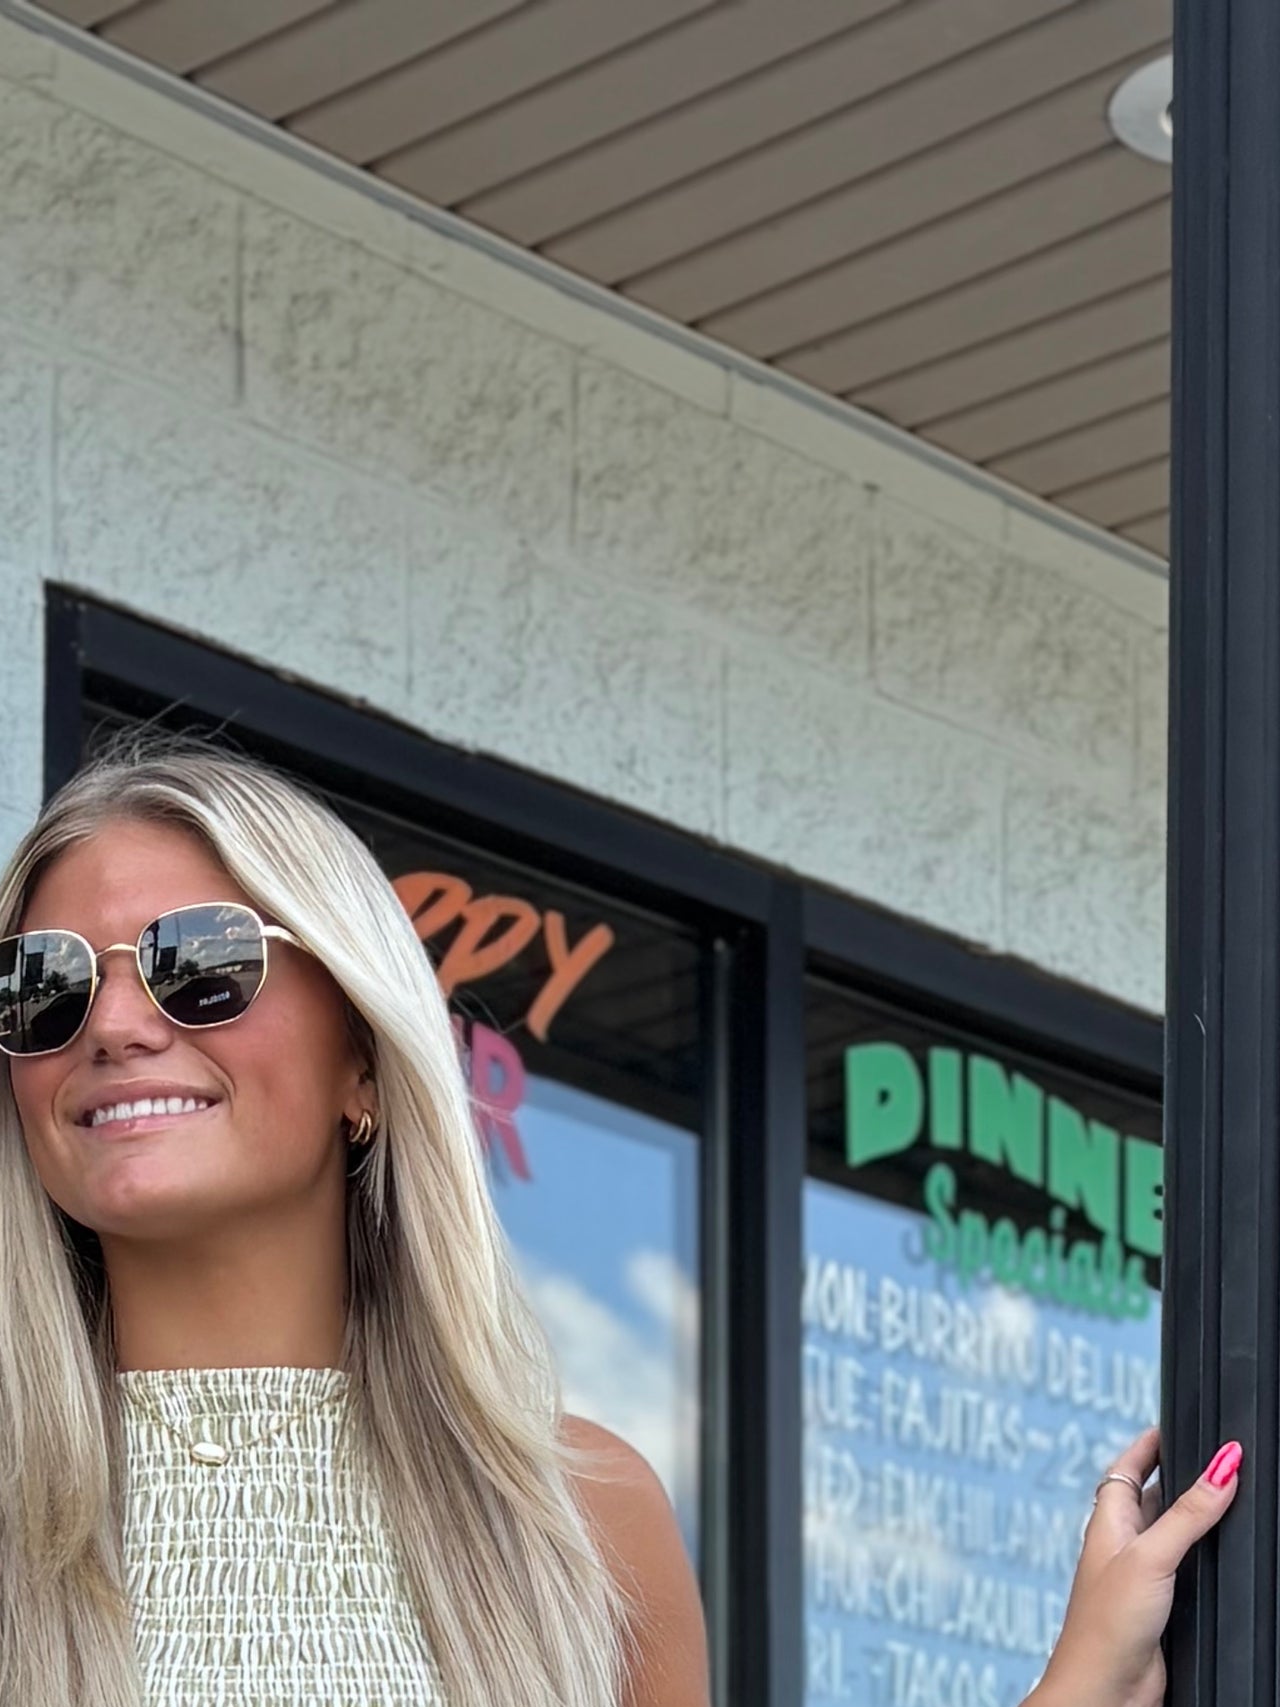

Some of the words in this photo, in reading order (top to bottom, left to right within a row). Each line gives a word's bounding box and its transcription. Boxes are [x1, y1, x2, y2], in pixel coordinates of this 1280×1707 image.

[389, 871, 615, 1043] PPY
[845, 1041, 1164, 1259] DINNE
[924, 1163, 1150, 1322] Specials
[1046, 1328, 1161, 1430] DELUX
